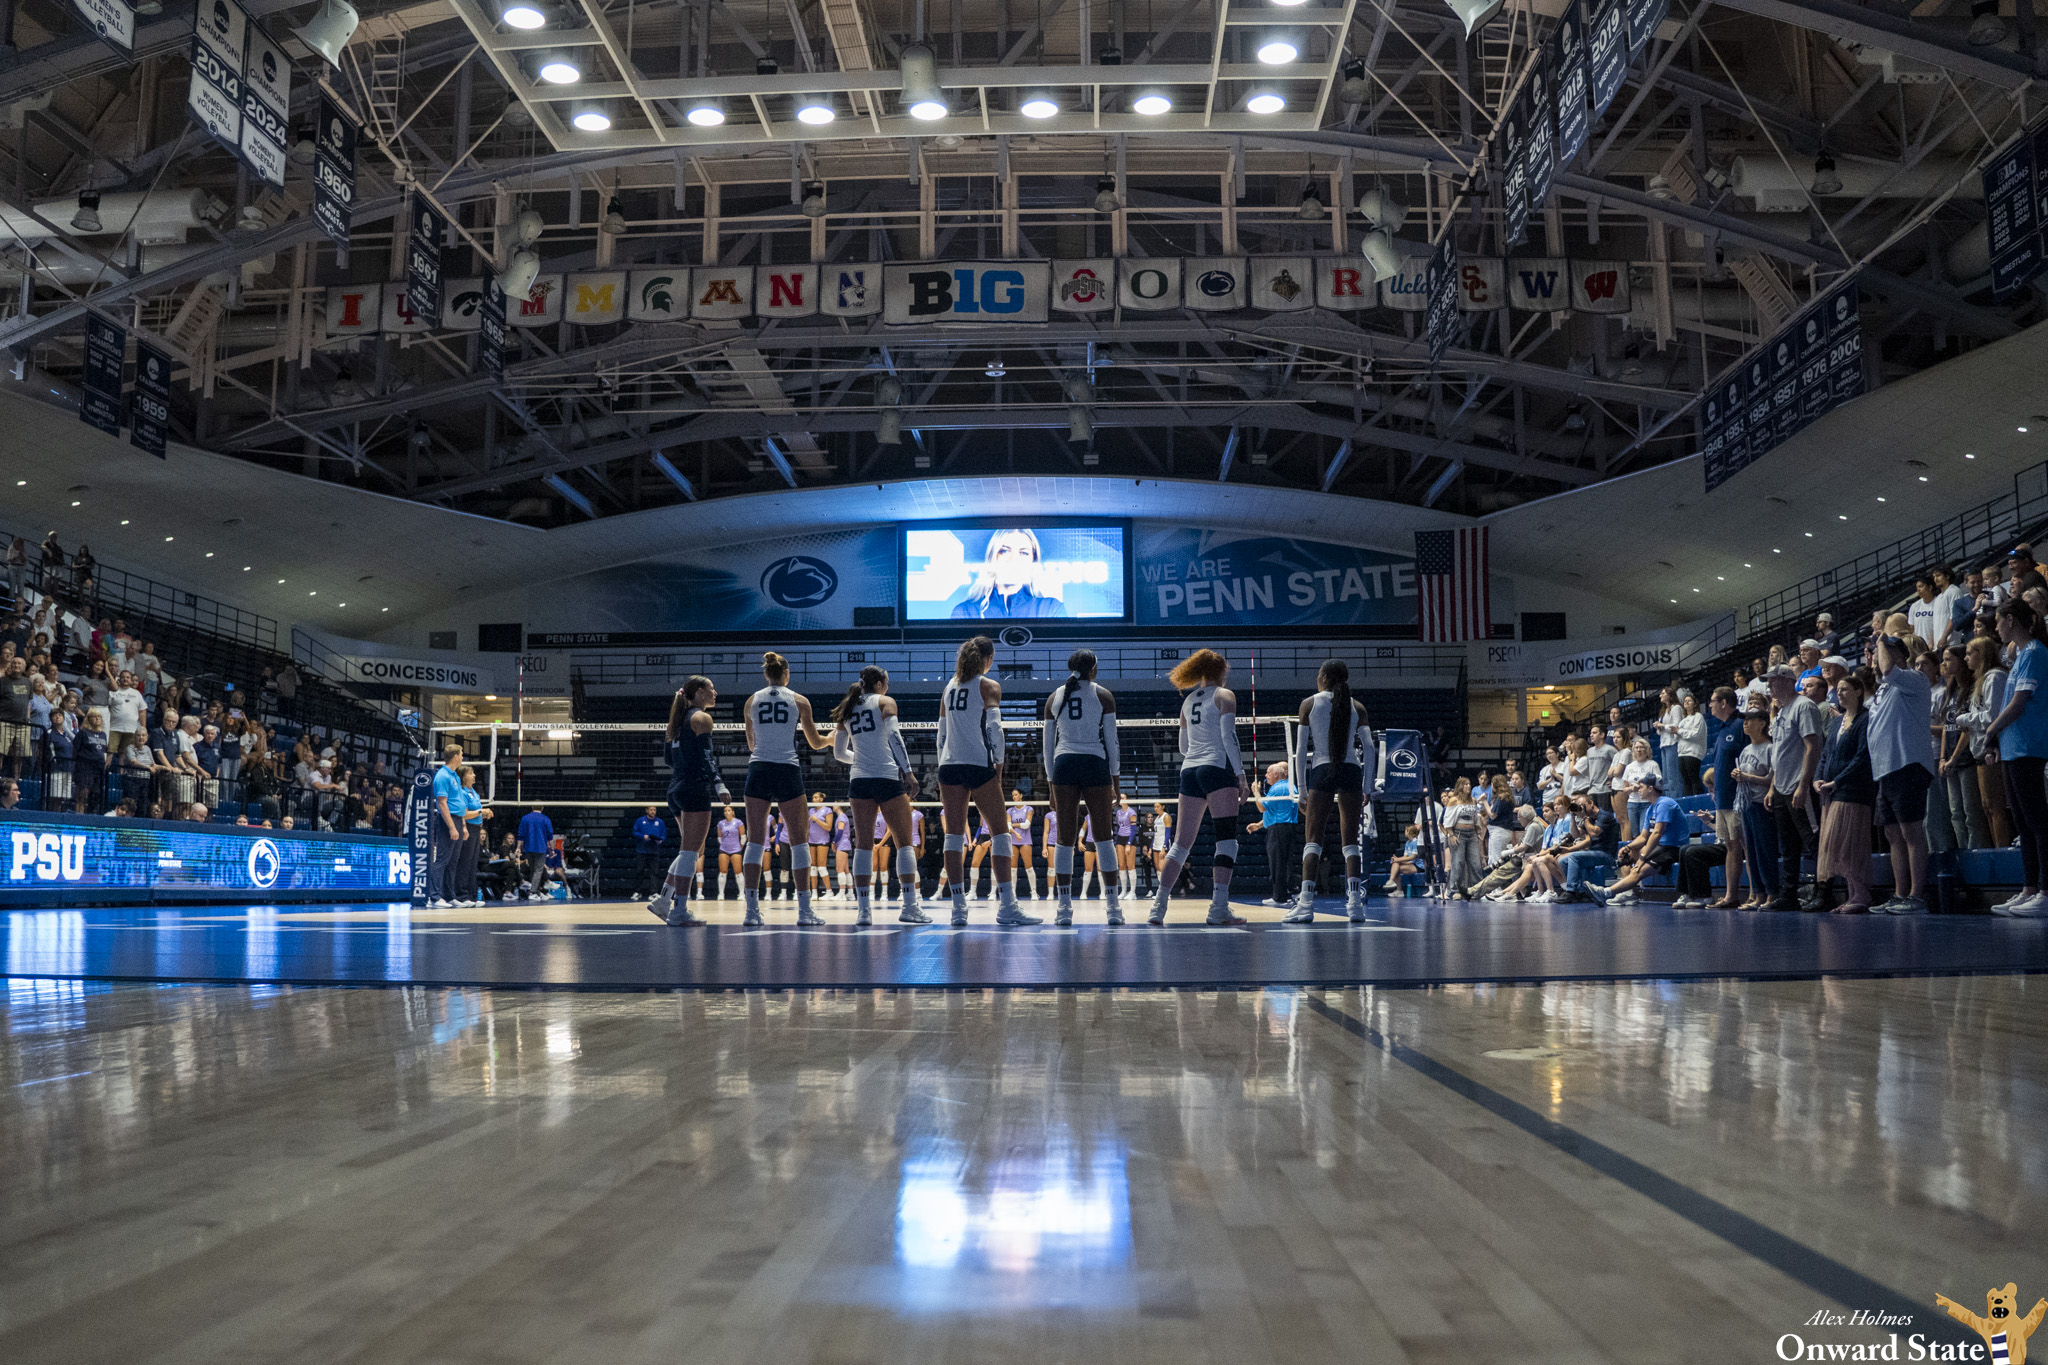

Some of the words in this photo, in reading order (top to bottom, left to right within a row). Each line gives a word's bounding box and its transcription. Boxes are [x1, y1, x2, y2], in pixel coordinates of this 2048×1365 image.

[84, 0, 125, 35] OLLEYBALL
[199, 17, 241, 63] CHAMPIONS
[1591, 8, 1620, 64] 2019
[197, 46, 239, 99] 2014
[250, 68, 287, 109] CHAMPIONS
[1559, 67, 1583, 119] 2018
[197, 96, 232, 132] VOLLEYBALL
[202, 89, 228, 119] WOMEN'S
[245, 95, 287, 146] 2024
[252, 137, 276, 163] WOMEN'S
[1529, 118, 1549, 164] 2017
[248, 143, 279, 175] VOLLEYBALL
[319, 161, 351, 202] 1960
[1988, 166, 2029, 203] CHAMPIONS
[412, 252, 437, 284] 1961
[2000, 250, 2032, 276] WRESTLING
[700, 280, 743, 305] M
[769, 273, 804, 308] N
[1130, 269, 1169, 299] O
[1331, 267, 1364, 298] R
[1518, 270, 1558, 299] W
[340, 294, 364, 326] I
[576, 284, 617, 313] M
[483, 317, 505, 345] 1965
[1829, 312, 1859, 337] CHAMPIONS
[90, 334, 122, 357] CHAMPIONS
[1800, 335, 1826, 359] CHAMPIONS
[1829, 335, 1860, 367] 2000
[1801, 358, 1827, 386] 1976
[1773, 378, 1797, 406] 1957
[136, 395, 167, 421] 1959
[1749, 399, 1770, 424] 1954
[1704, 435, 1724, 458] 1948
[1141, 564, 1178, 583] WE
[1185, 558, 1232, 580] ARE
[1157, 575, 1275, 618] PENN
[1287, 562, 1419, 606] STATE
[546, 634, 573, 644] PENN
[577, 634, 609, 644] STATE
[1378, 648, 1393, 656] 220
[514, 656, 548, 673] PSECU
[648, 657, 662, 665] 217
[849, 653, 863, 662] 218
[1163, 651, 1177, 660] 219
[1559, 649, 1672, 676] CONCESSIONS
[361, 662, 478, 687] CONCESSIONS
[758, 701, 789, 724] 26
[949, 688, 970, 711] 18
[1068, 697, 1082, 720] 8
[1191, 702, 1202, 725] 5
[849, 709, 876, 736] 23
[10, 832, 87, 881] PSU
[389, 851, 411, 884] PS
[413, 853, 428, 898] PENN
